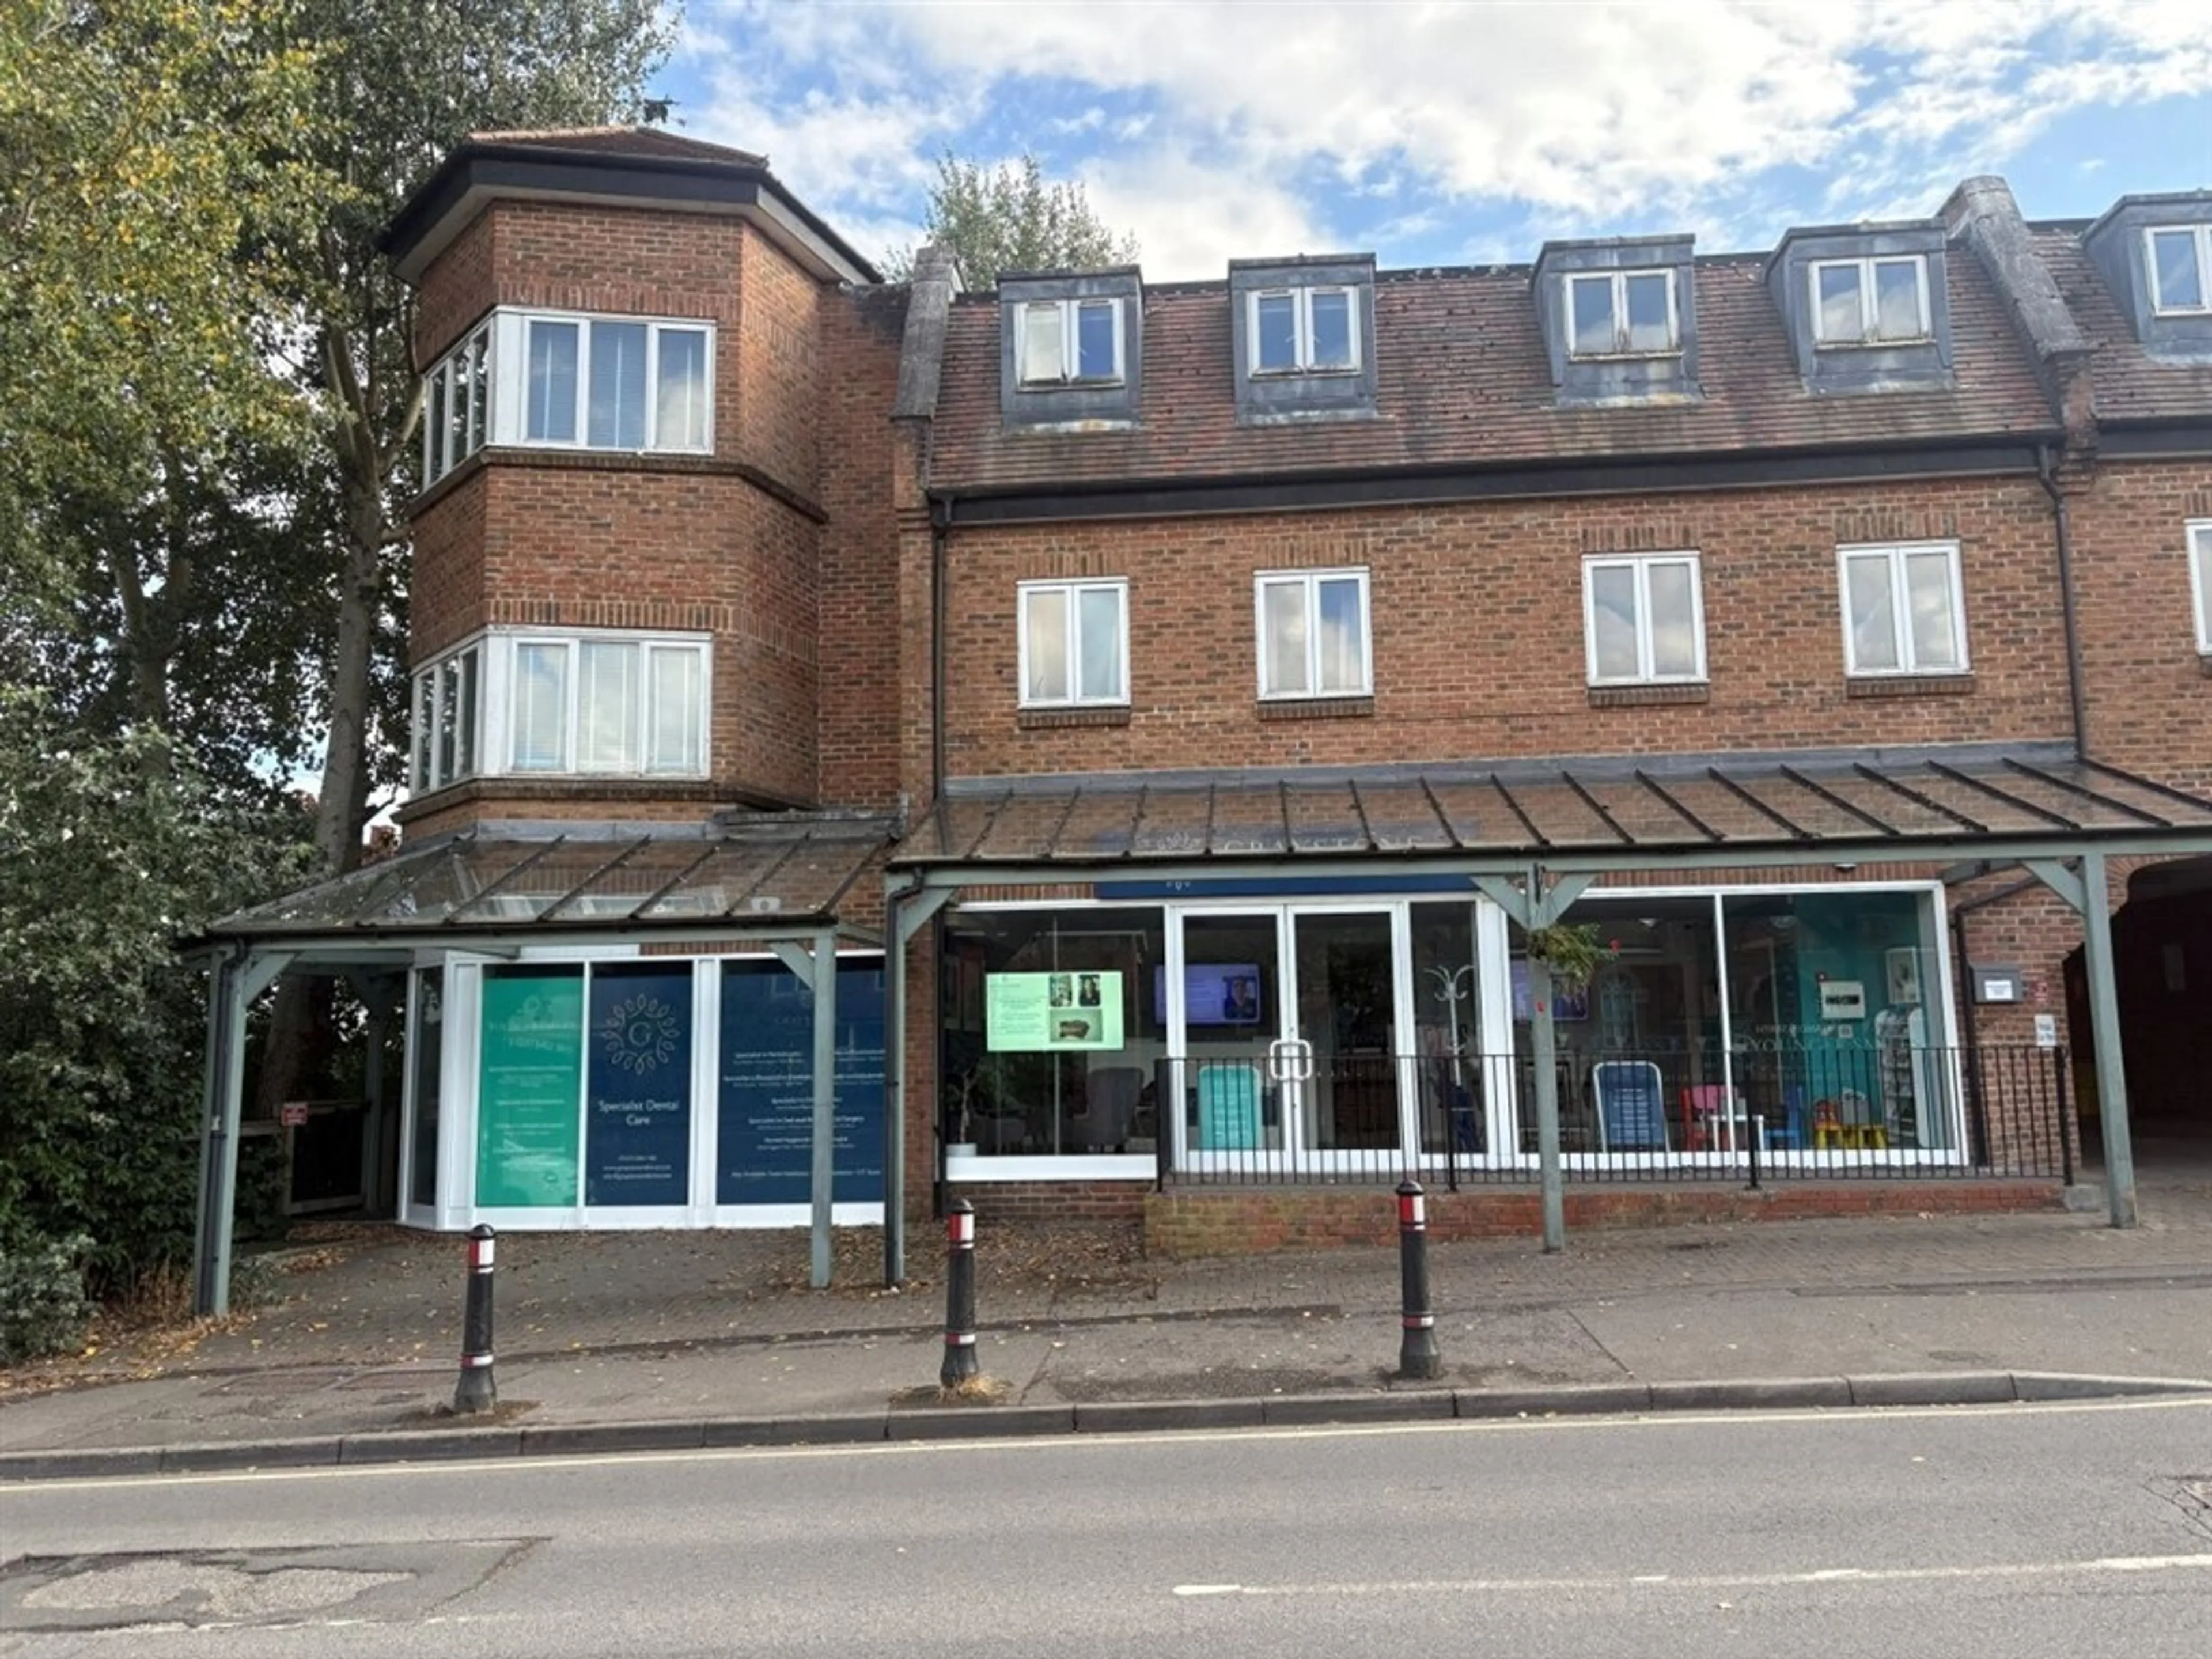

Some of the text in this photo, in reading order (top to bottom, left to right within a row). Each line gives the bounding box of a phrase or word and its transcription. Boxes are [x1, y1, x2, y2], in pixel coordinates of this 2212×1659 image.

[628, 1021, 652, 1047] G
[597, 1099, 679, 1113] Specialist Dental
[626, 1114, 650, 1126] Care
